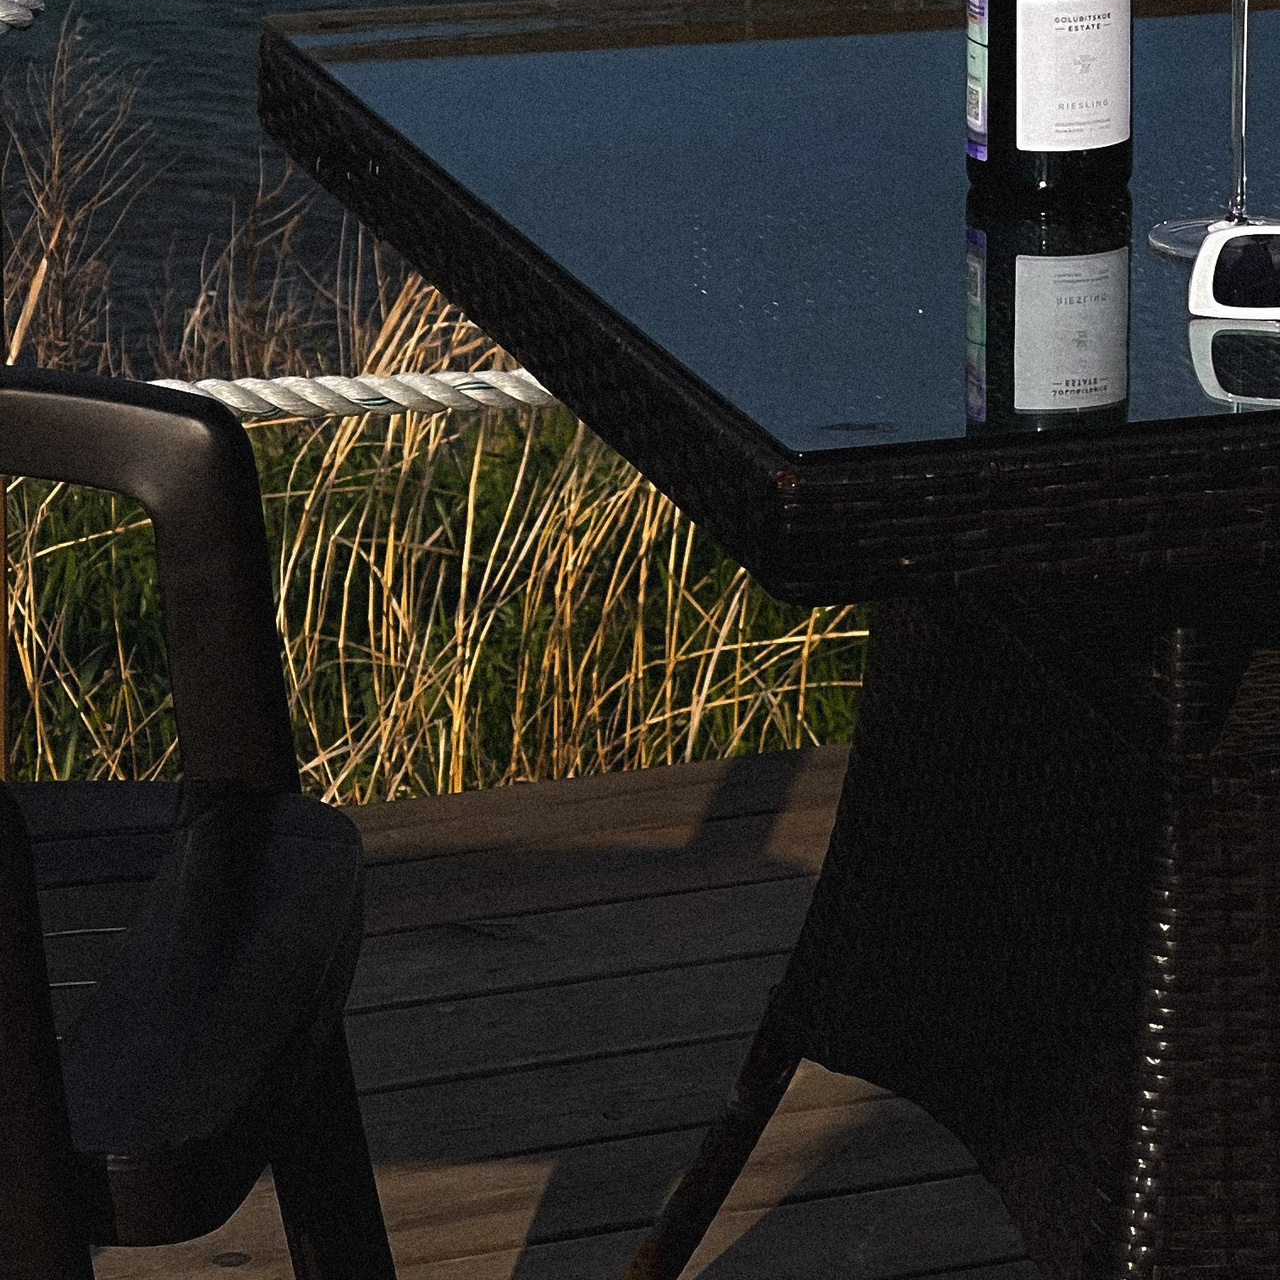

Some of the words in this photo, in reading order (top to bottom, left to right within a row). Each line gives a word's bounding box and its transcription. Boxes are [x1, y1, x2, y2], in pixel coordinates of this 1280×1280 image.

[1054, 12, 1111, 23] GOLUBITSKOE
[1068, 23, 1100, 32] ESTATE
[1058, 99, 1109, 110] RIESLING
